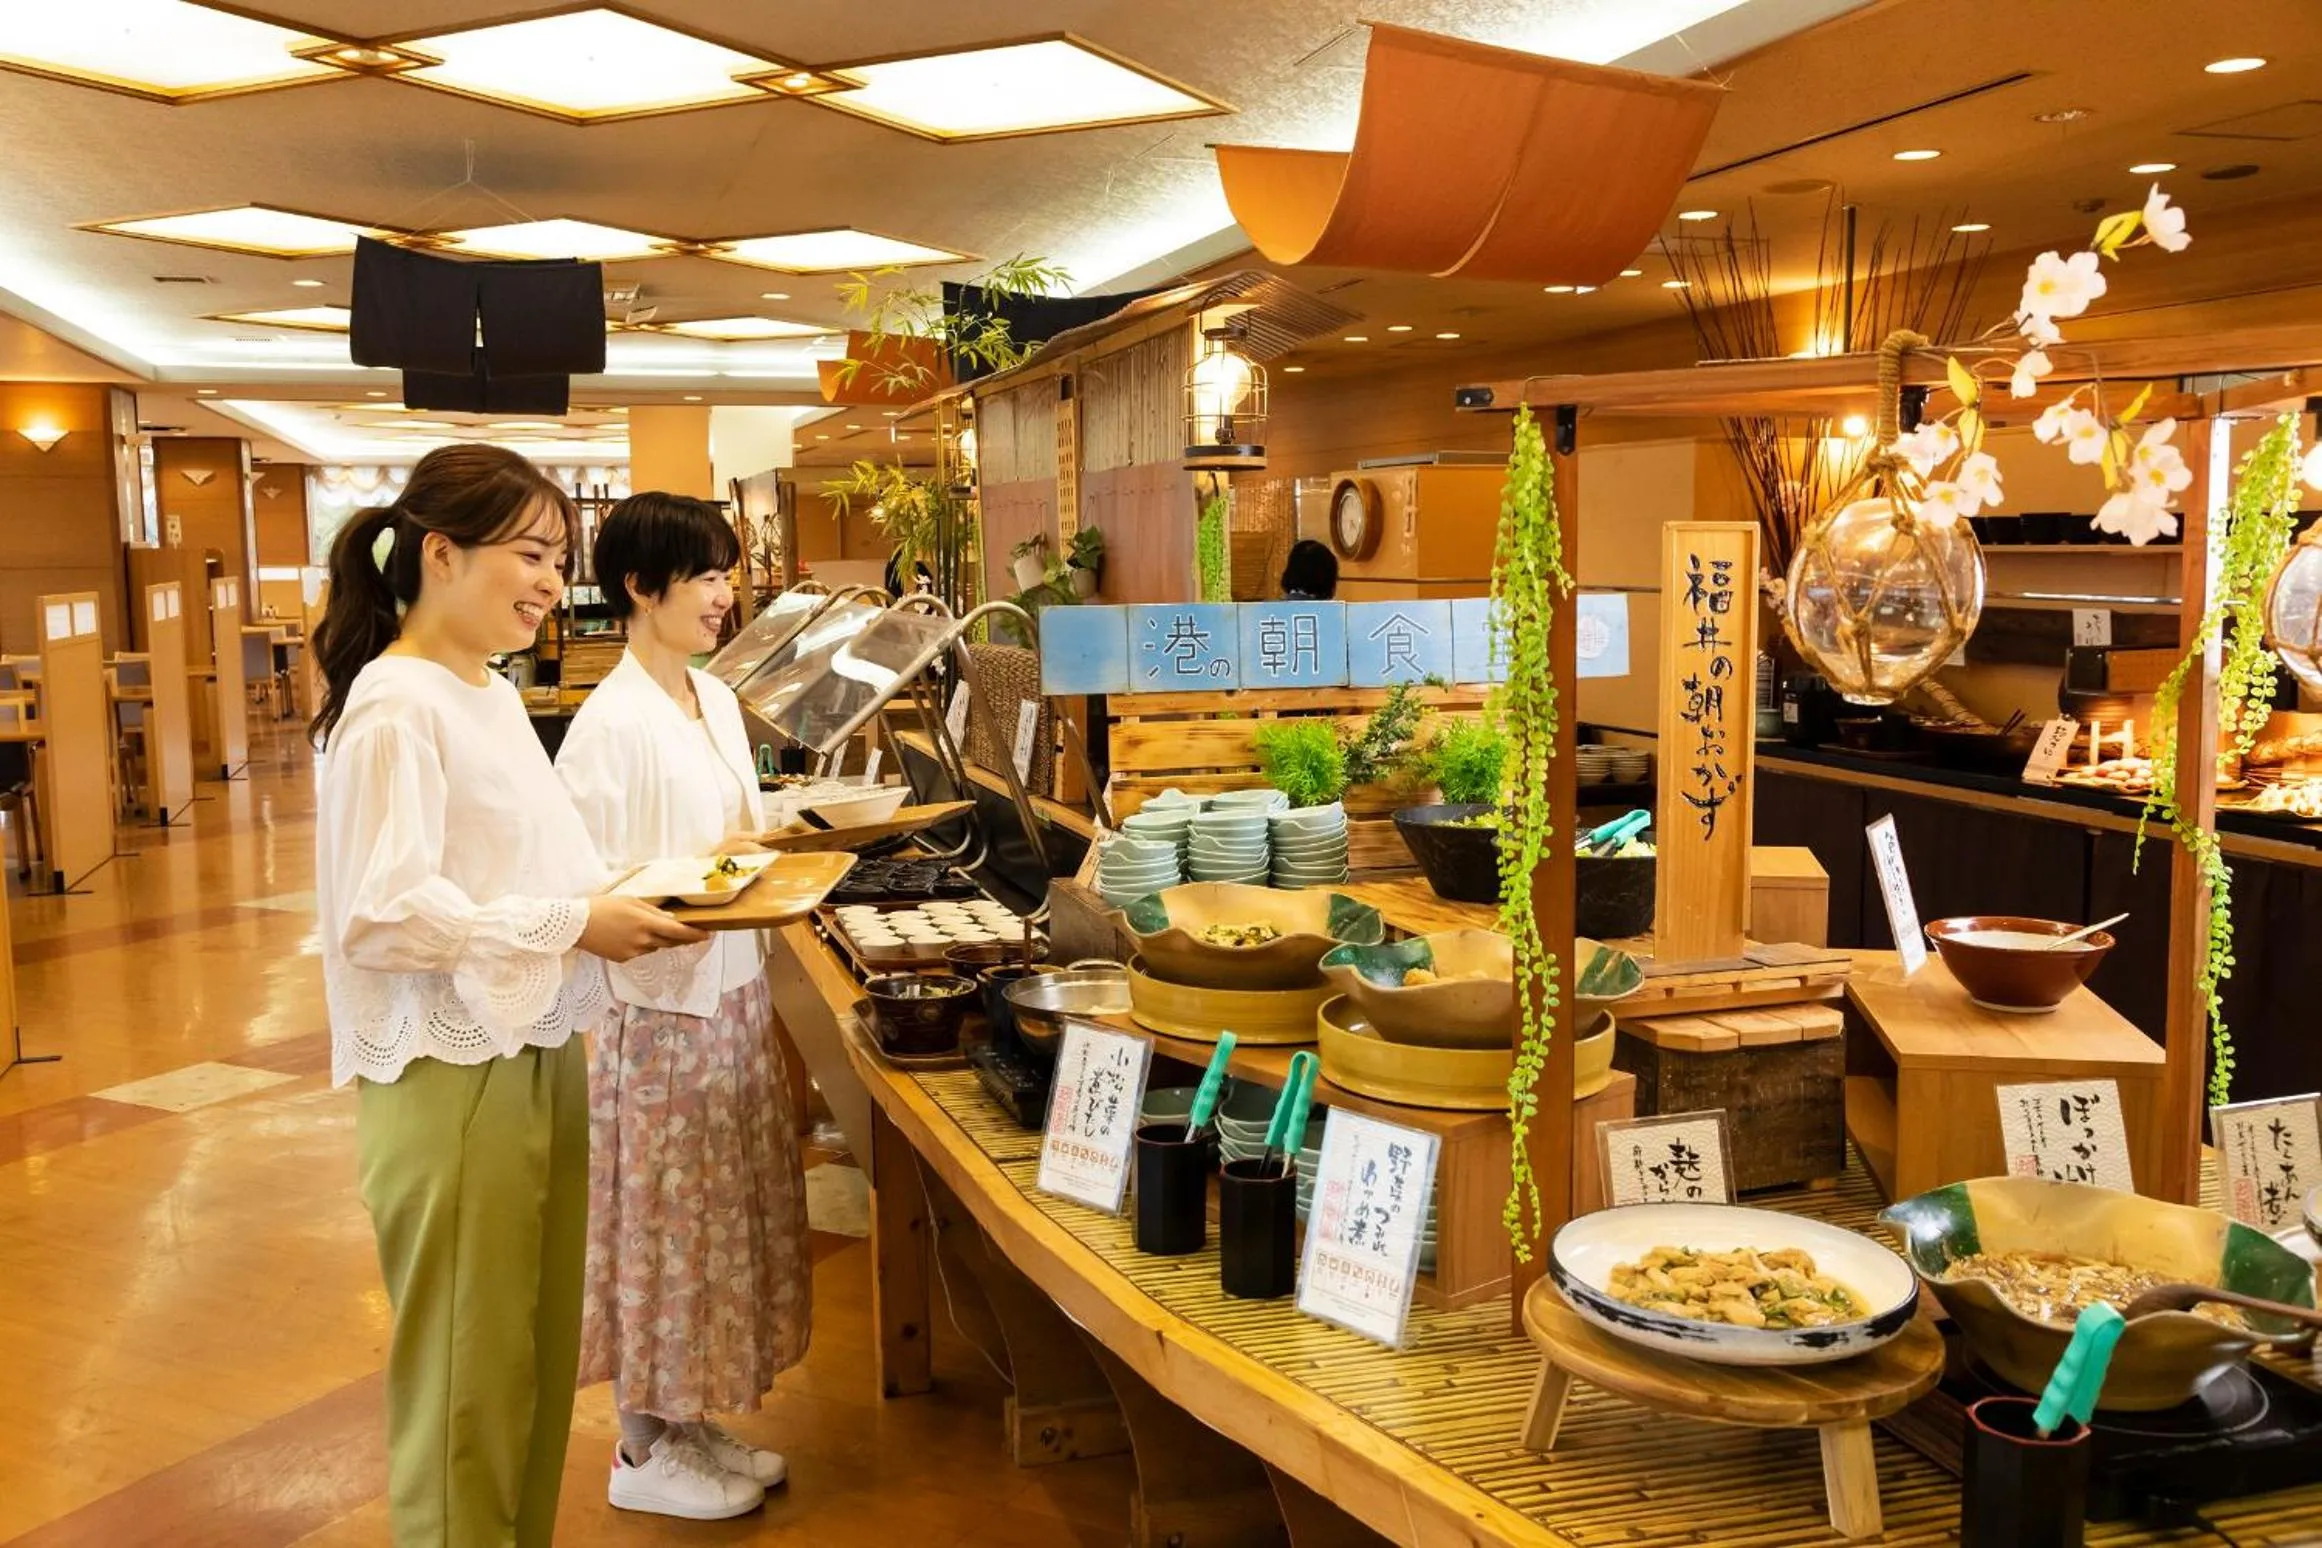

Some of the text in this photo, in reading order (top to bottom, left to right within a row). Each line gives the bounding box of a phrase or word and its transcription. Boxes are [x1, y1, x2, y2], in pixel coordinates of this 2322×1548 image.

[1144, 612, 1512, 678] 港の朝食
[1681, 553, 1743, 841] 福井の朝おかず
[1099, 1047, 1130, 1136] 小松菜の
